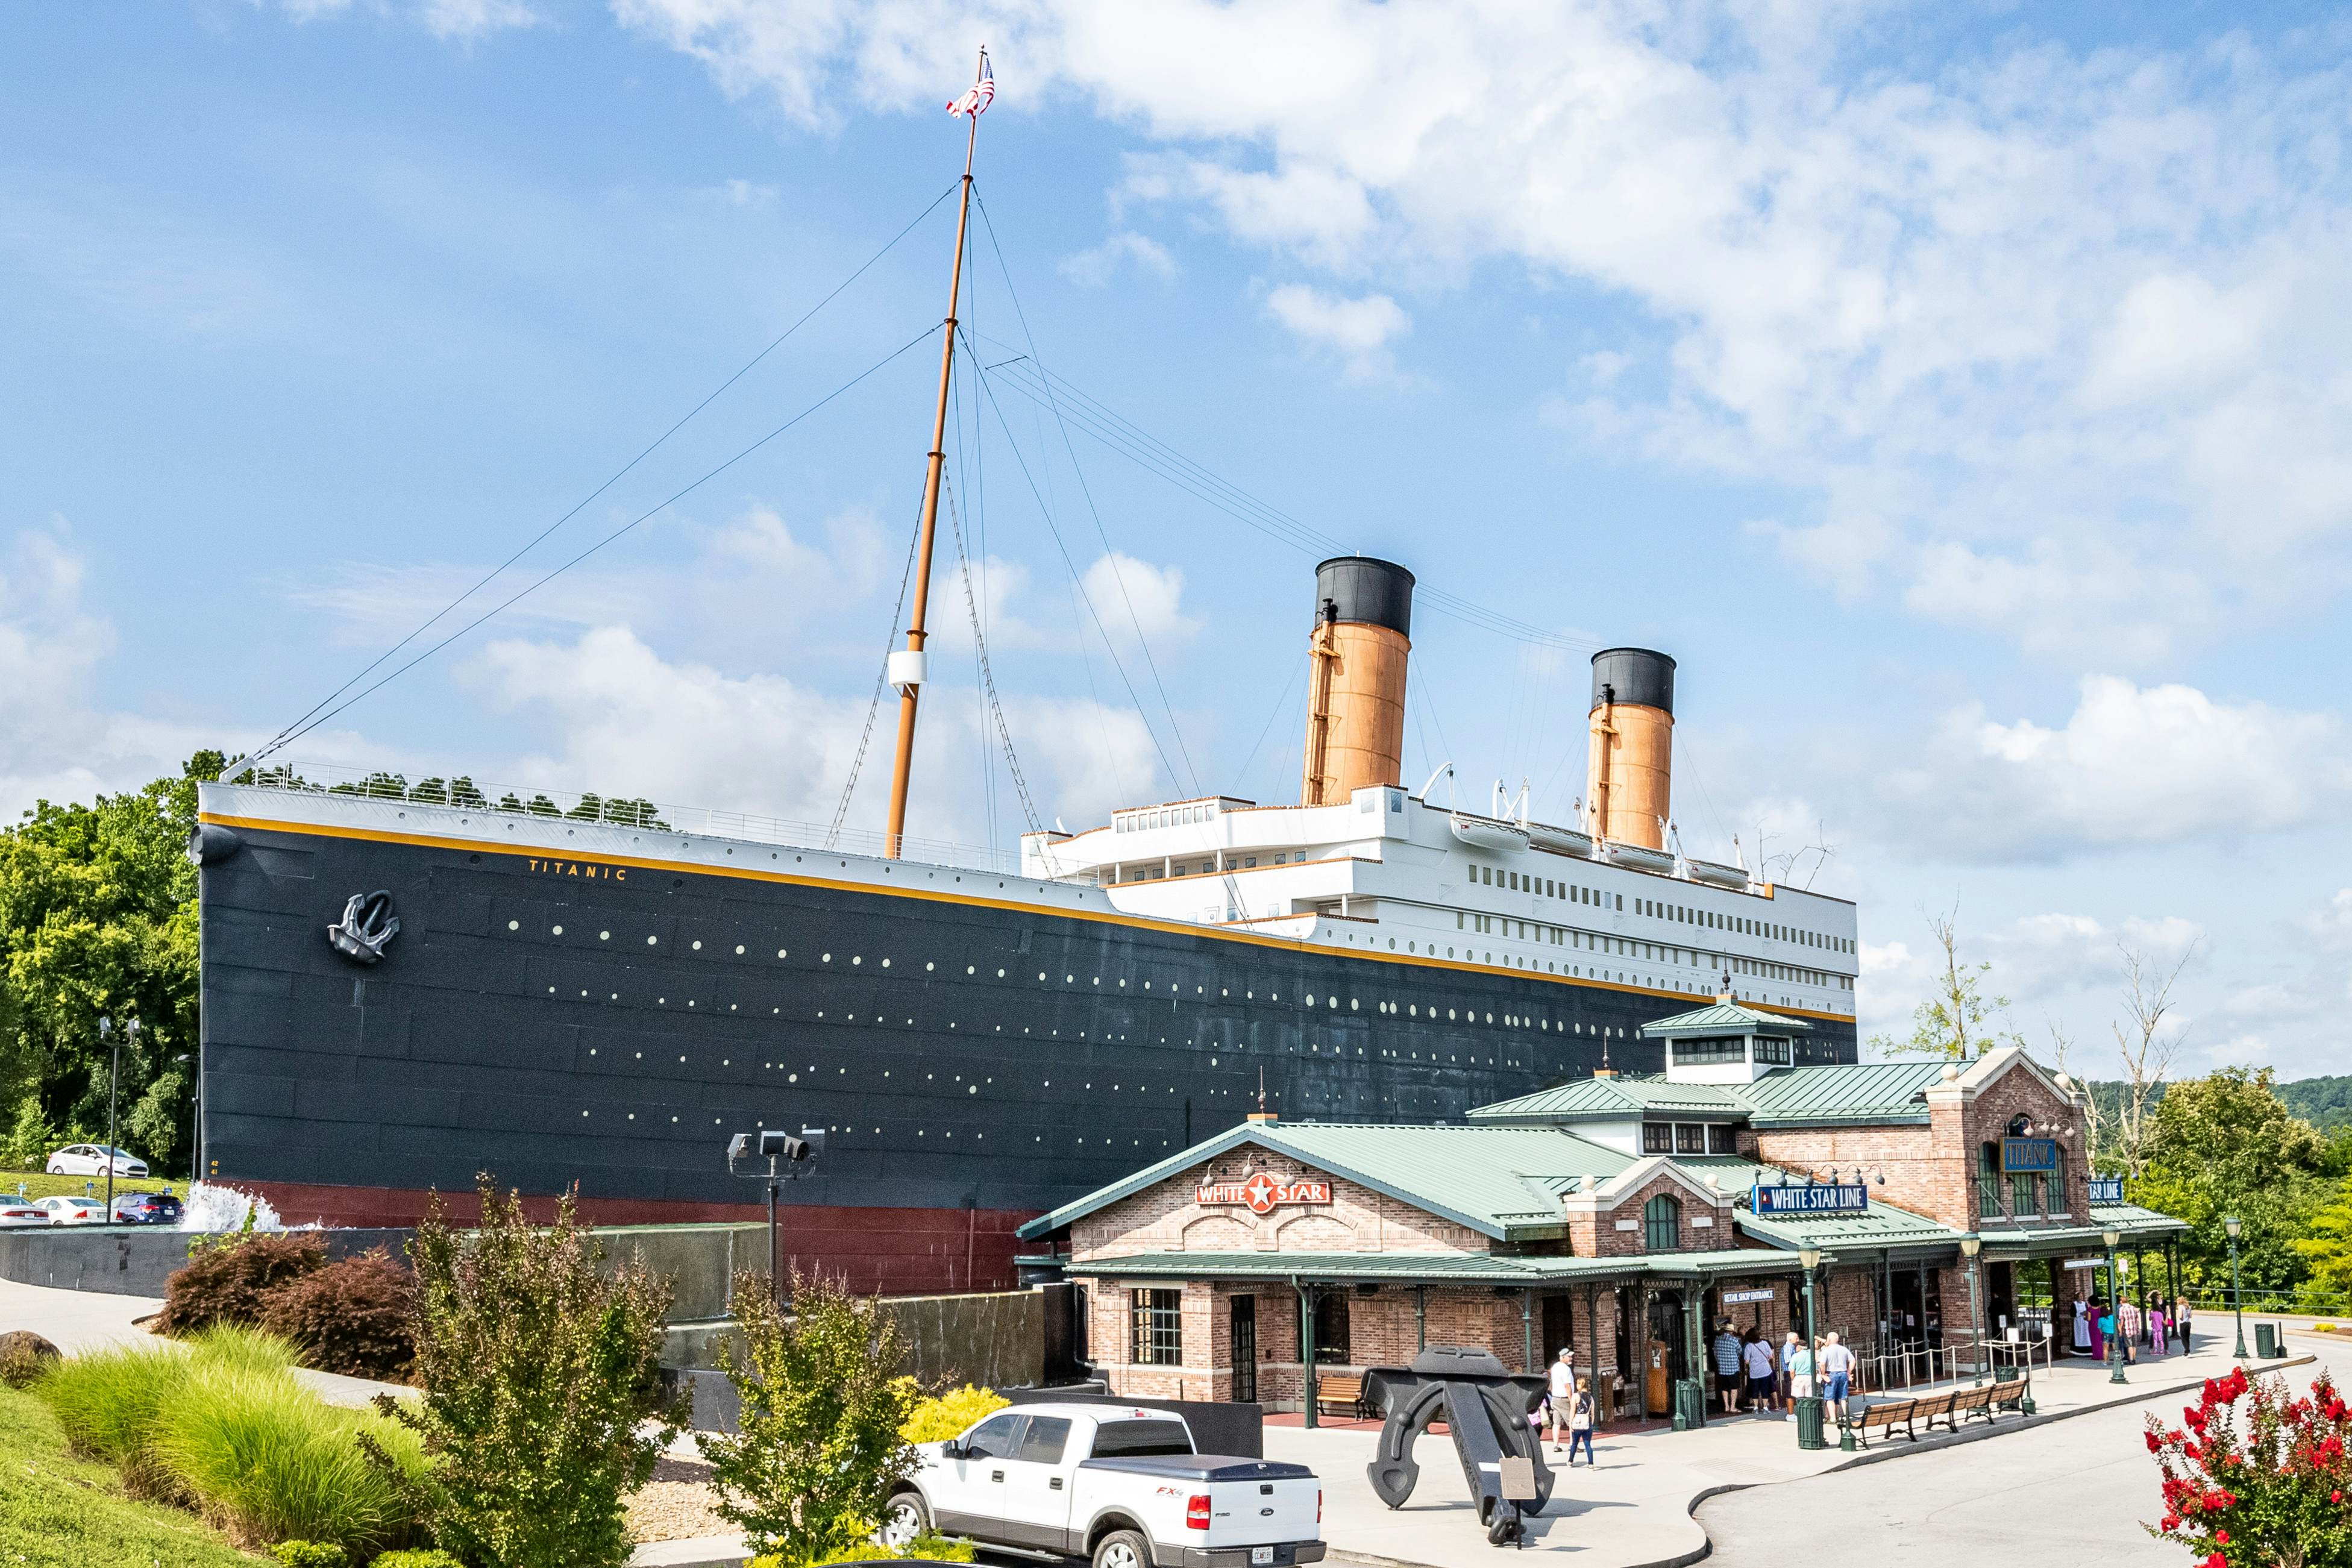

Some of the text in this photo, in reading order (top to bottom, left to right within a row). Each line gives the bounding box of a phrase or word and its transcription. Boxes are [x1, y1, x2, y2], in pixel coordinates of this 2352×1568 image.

[529, 859, 626, 881] TITANIC
[2005, 1142, 2054, 1166] TITANIC
[1199, 1184, 1323, 1202] WHITE STAR
[1770, 1187, 1863, 1209] WHITE STAR LINE
[2088, 1182, 2119, 1199] TAR LINE
[1723, 1290, 1774, 1302] RETAIL SHOP ENTRANCE
[1156, 1487, 1184, 1496] FX4
